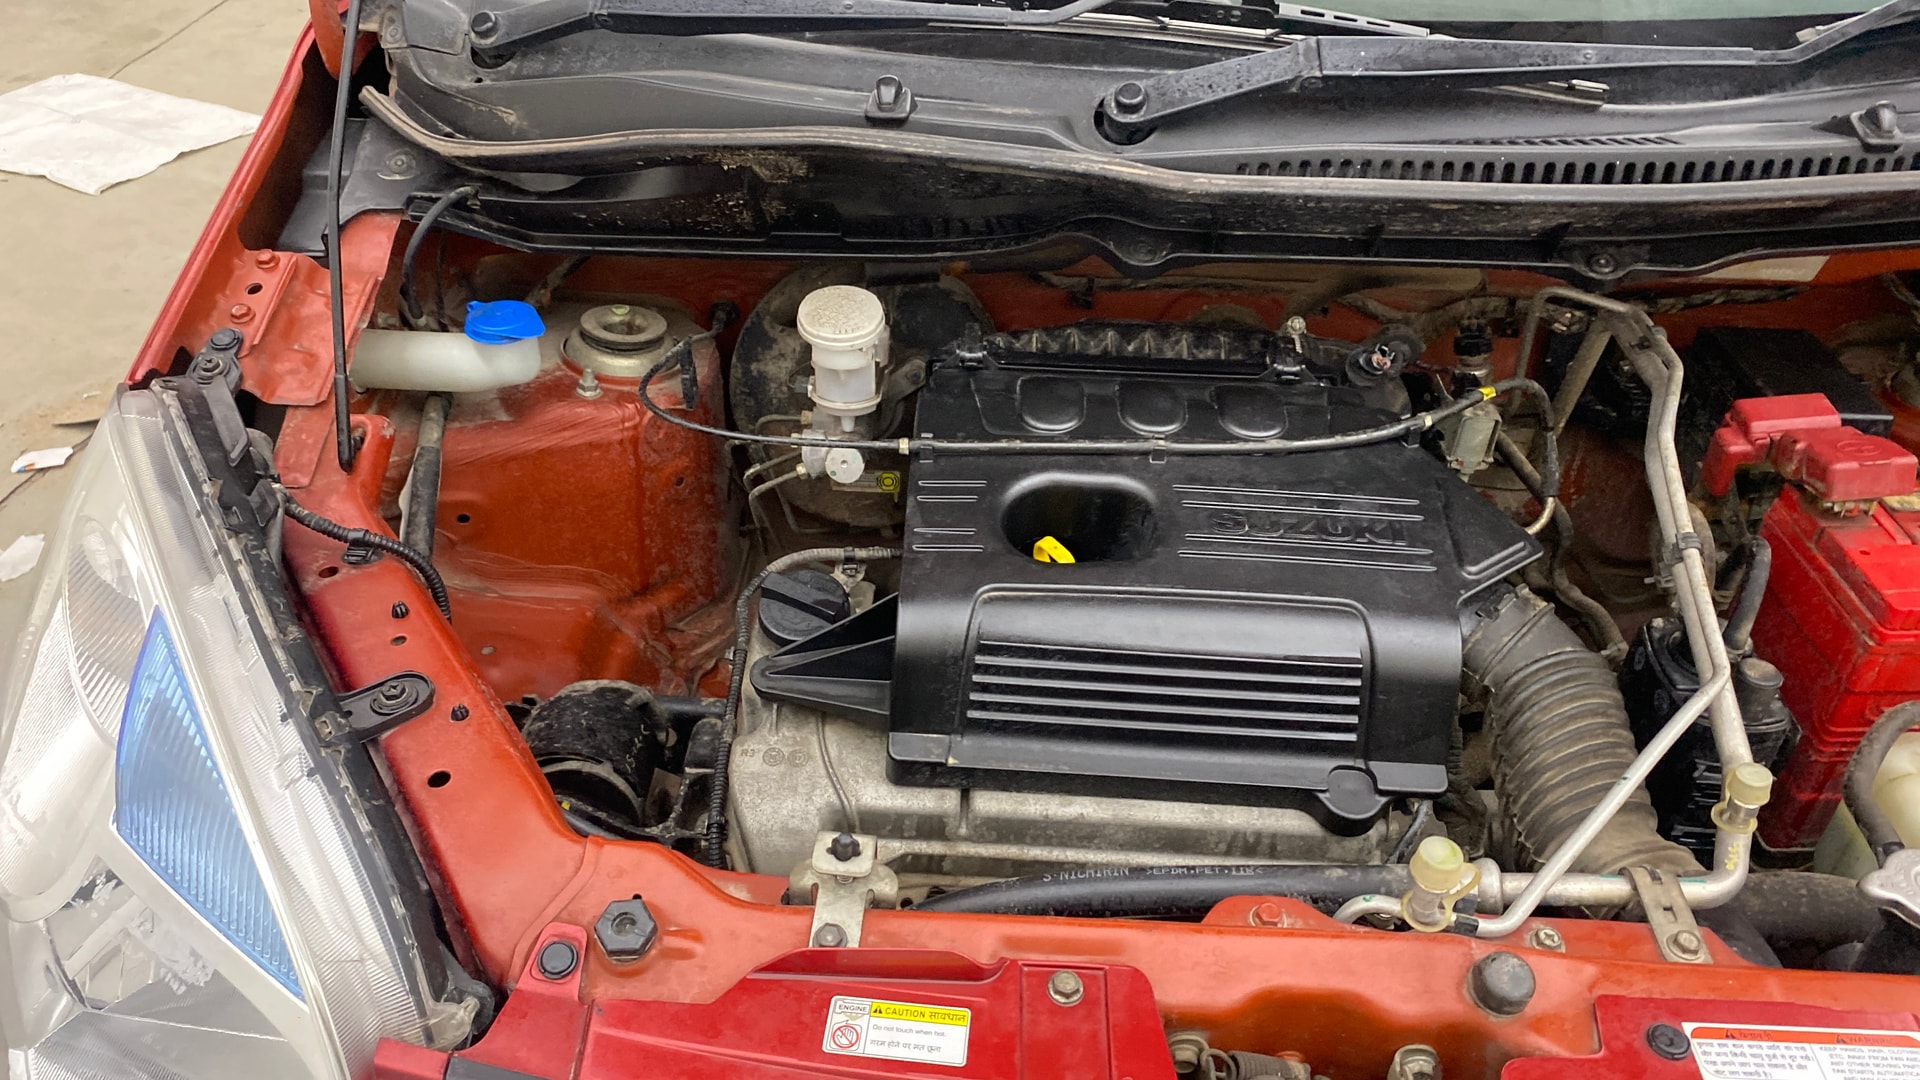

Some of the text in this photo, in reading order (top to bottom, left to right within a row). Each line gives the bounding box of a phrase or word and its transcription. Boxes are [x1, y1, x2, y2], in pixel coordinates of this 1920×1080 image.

[1213, 510, 1408, 546] SUZUKI
[838, 1003, 868, 1013] ENGINE
[884, 1007, 967, 1023] CAUTION सावधान
[895, 1026, 914, 1034] touch
[915, 1028, 933, 1036] when
